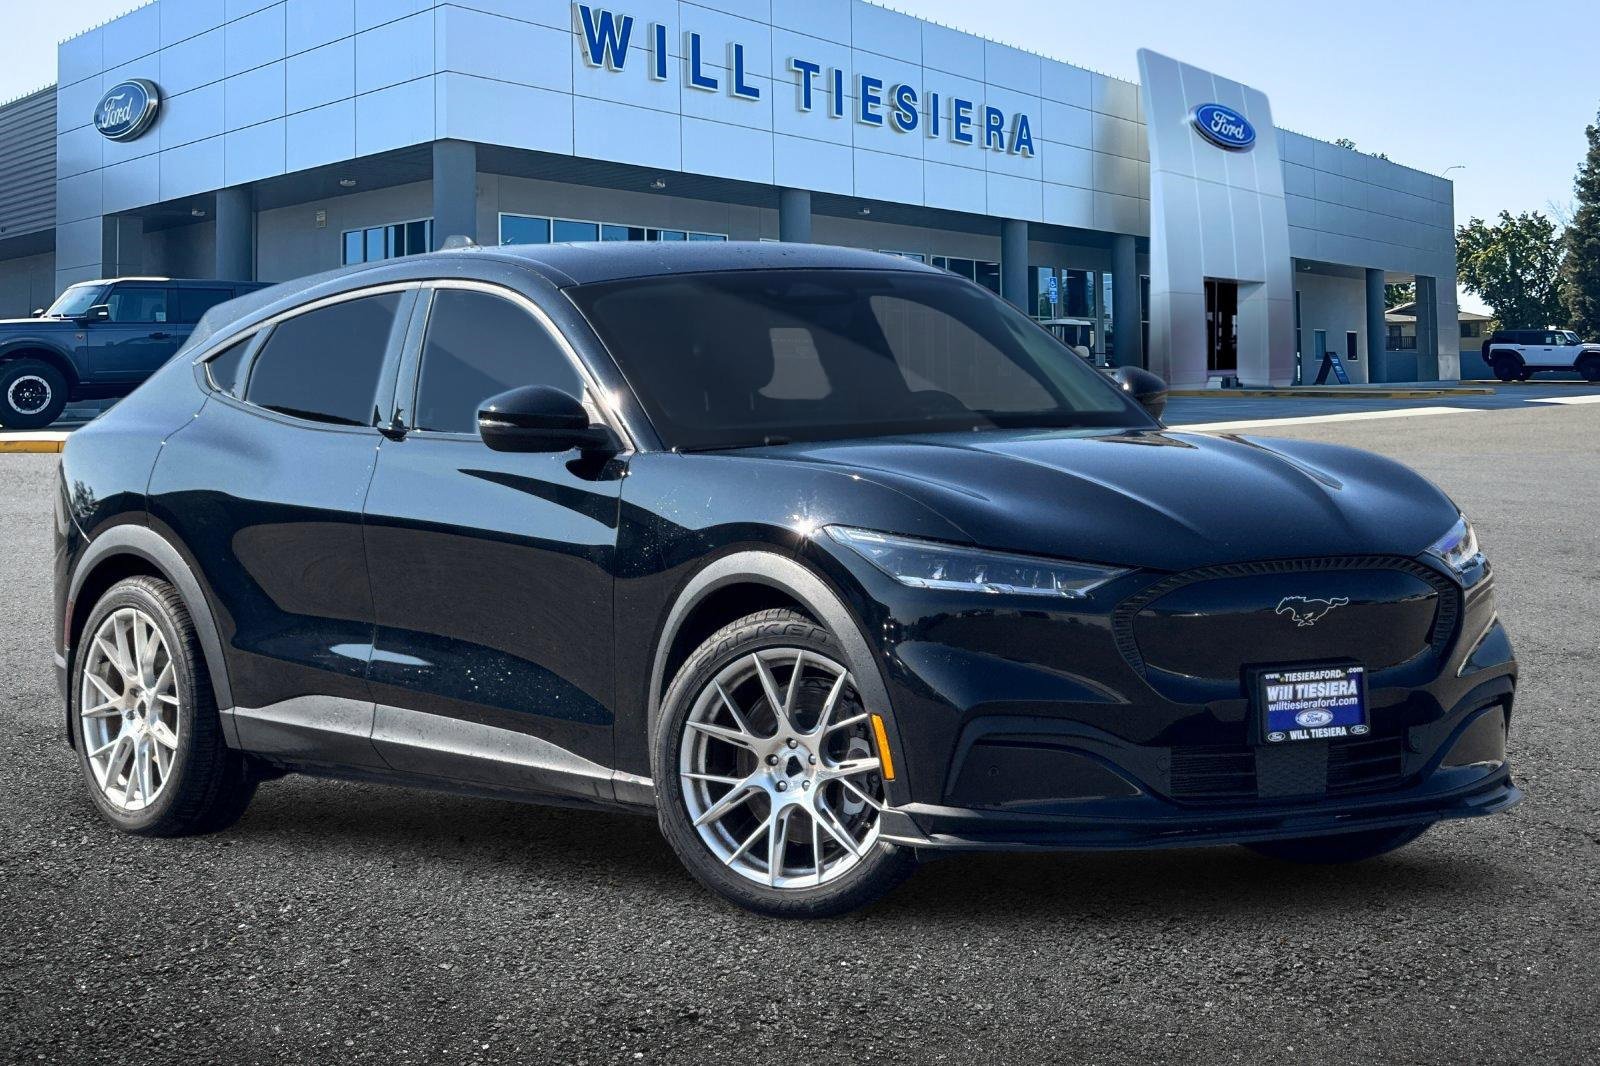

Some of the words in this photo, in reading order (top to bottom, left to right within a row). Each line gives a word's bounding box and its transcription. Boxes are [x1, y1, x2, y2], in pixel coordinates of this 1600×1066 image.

[574, 2, 760, 101] WILL
[789, 57, 1036, 158] TIESIERA
[1295, 680, 1358, 699] TIESIERA
[1268, 696, 1358, 712] willtiesieraford.com
[1289, 730, 1310, 740] WILL
[1310, 726, 1347, 739] TIESIERA
